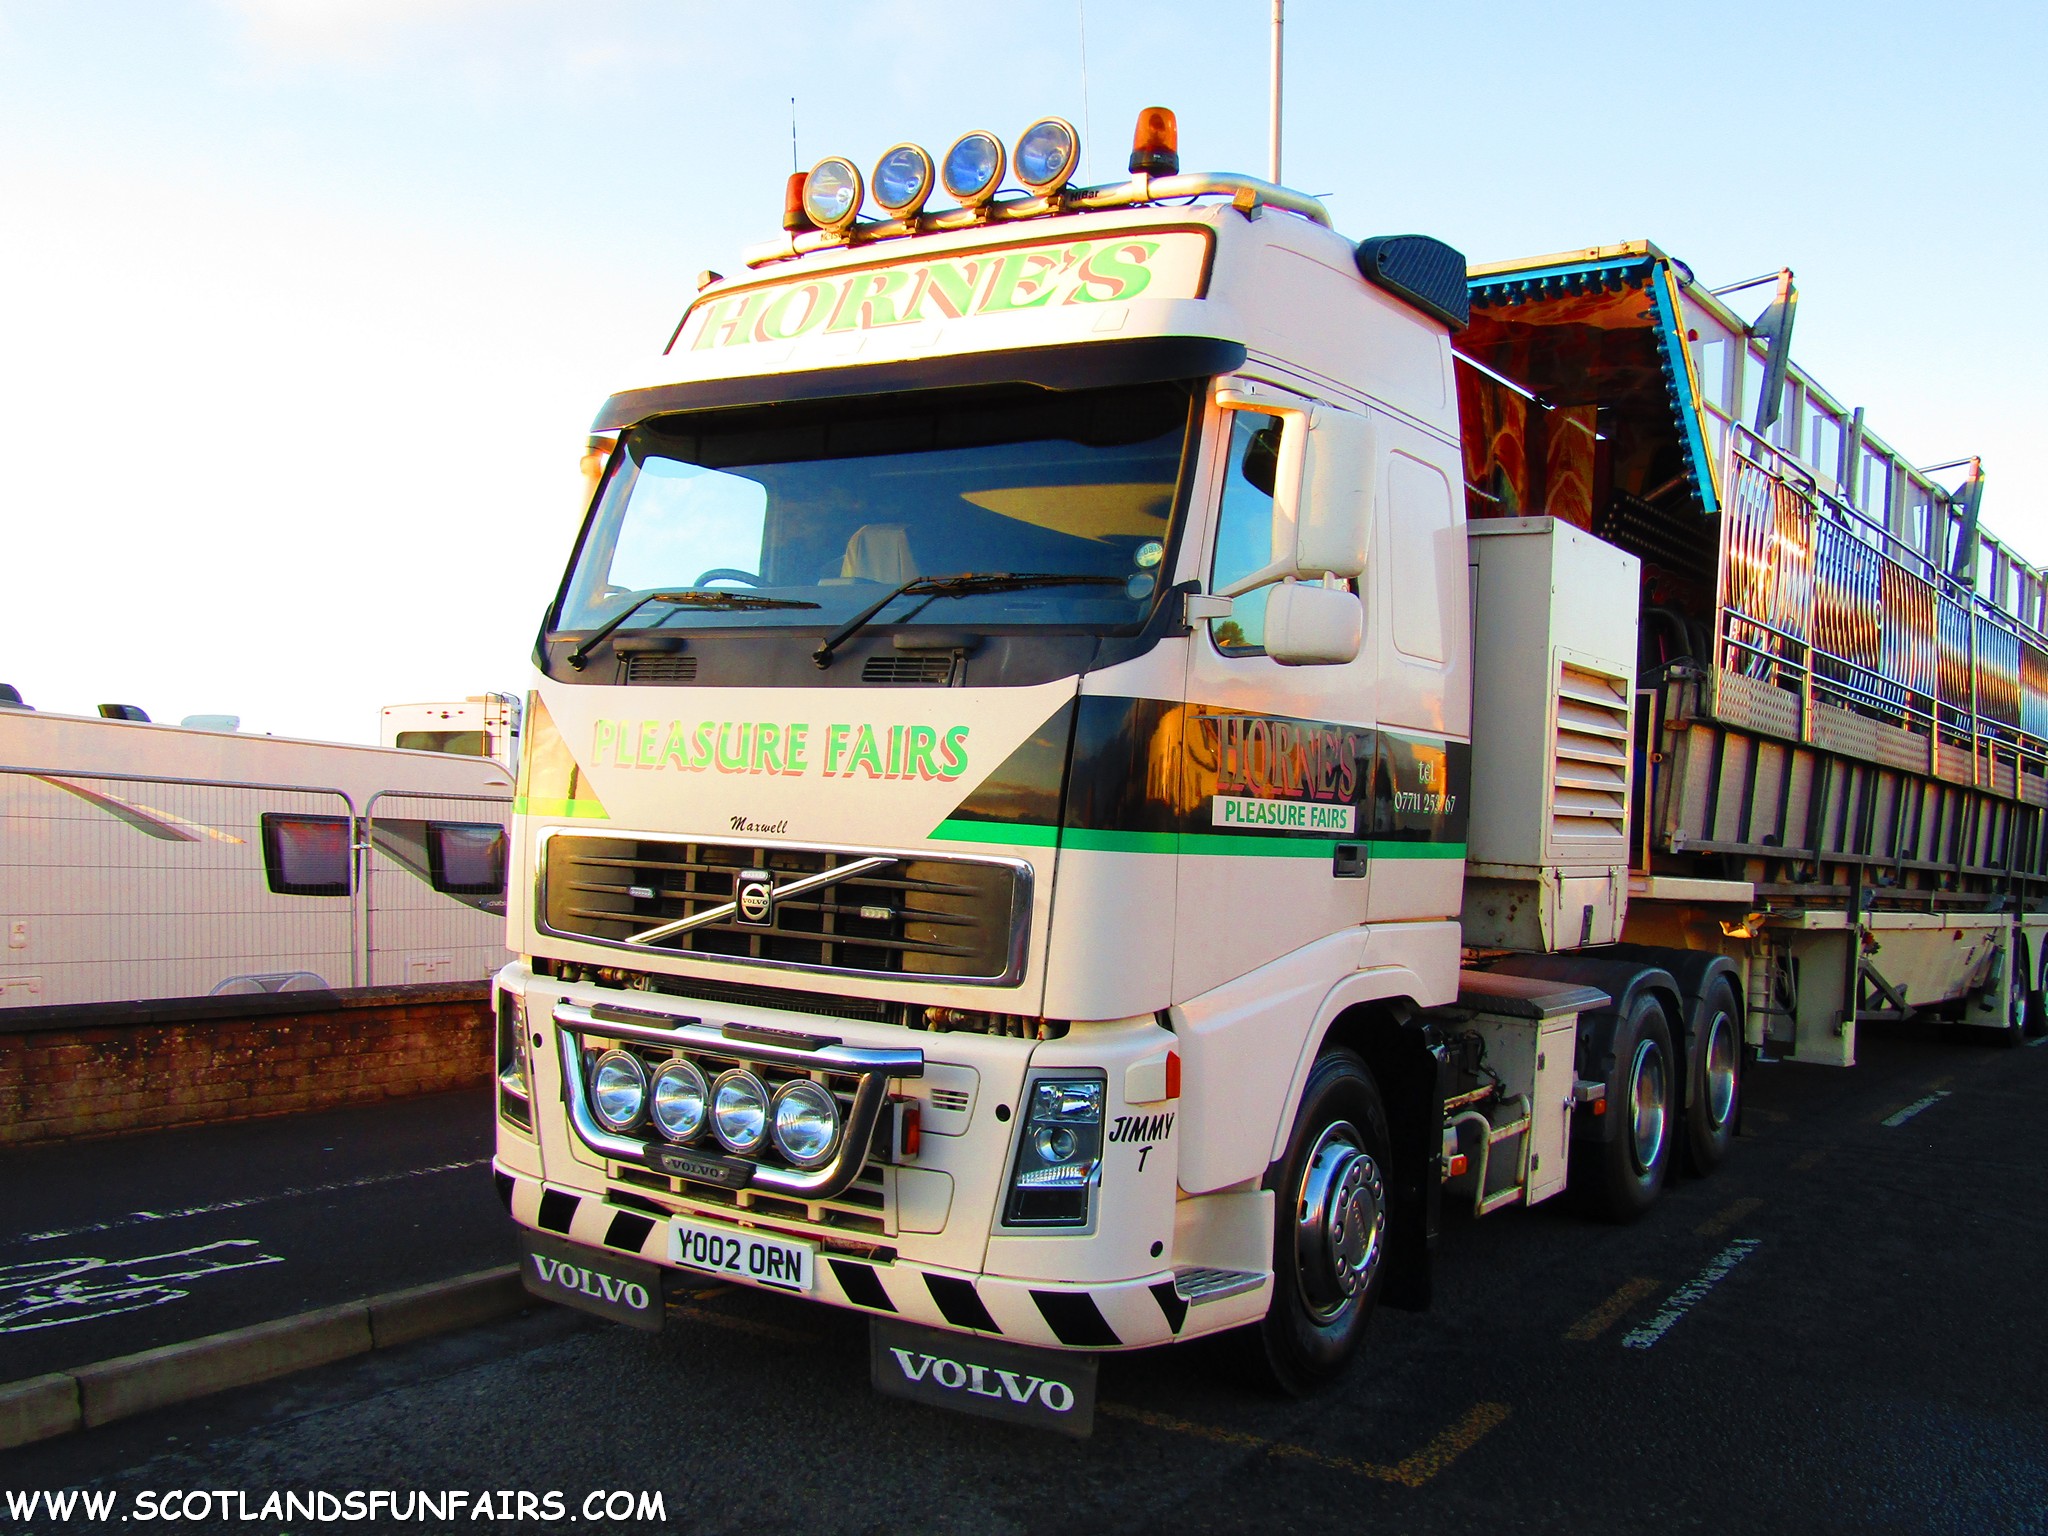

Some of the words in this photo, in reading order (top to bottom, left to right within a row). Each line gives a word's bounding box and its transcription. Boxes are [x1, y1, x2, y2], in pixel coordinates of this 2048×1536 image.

[692, 241, 1162, 351] HORNE'S
[591, 718, 809, 774] PLEASURE
[822, 724, 970, 782] FAIRS
[1216, 715, 1358, 802] HORNE'S
[730, 816, 788, 835] Maxwell
[1225, 800, 1305, 827] PLEASURE
[1310, 806, 1347, 829] FAIRS
[742, 897, 769, 906] VOLVO
[1109, 1112, 1175, 1142] JIMMY
[671, 1158, 719, 1178] VOLVO
[1138, 1145, 1153, 1172] T
[749, 1243, 802, 1282] ORN
[531, 1253, 650, 1311] VOLVO
[889, 1347, 1075, 1412] VOLVO
